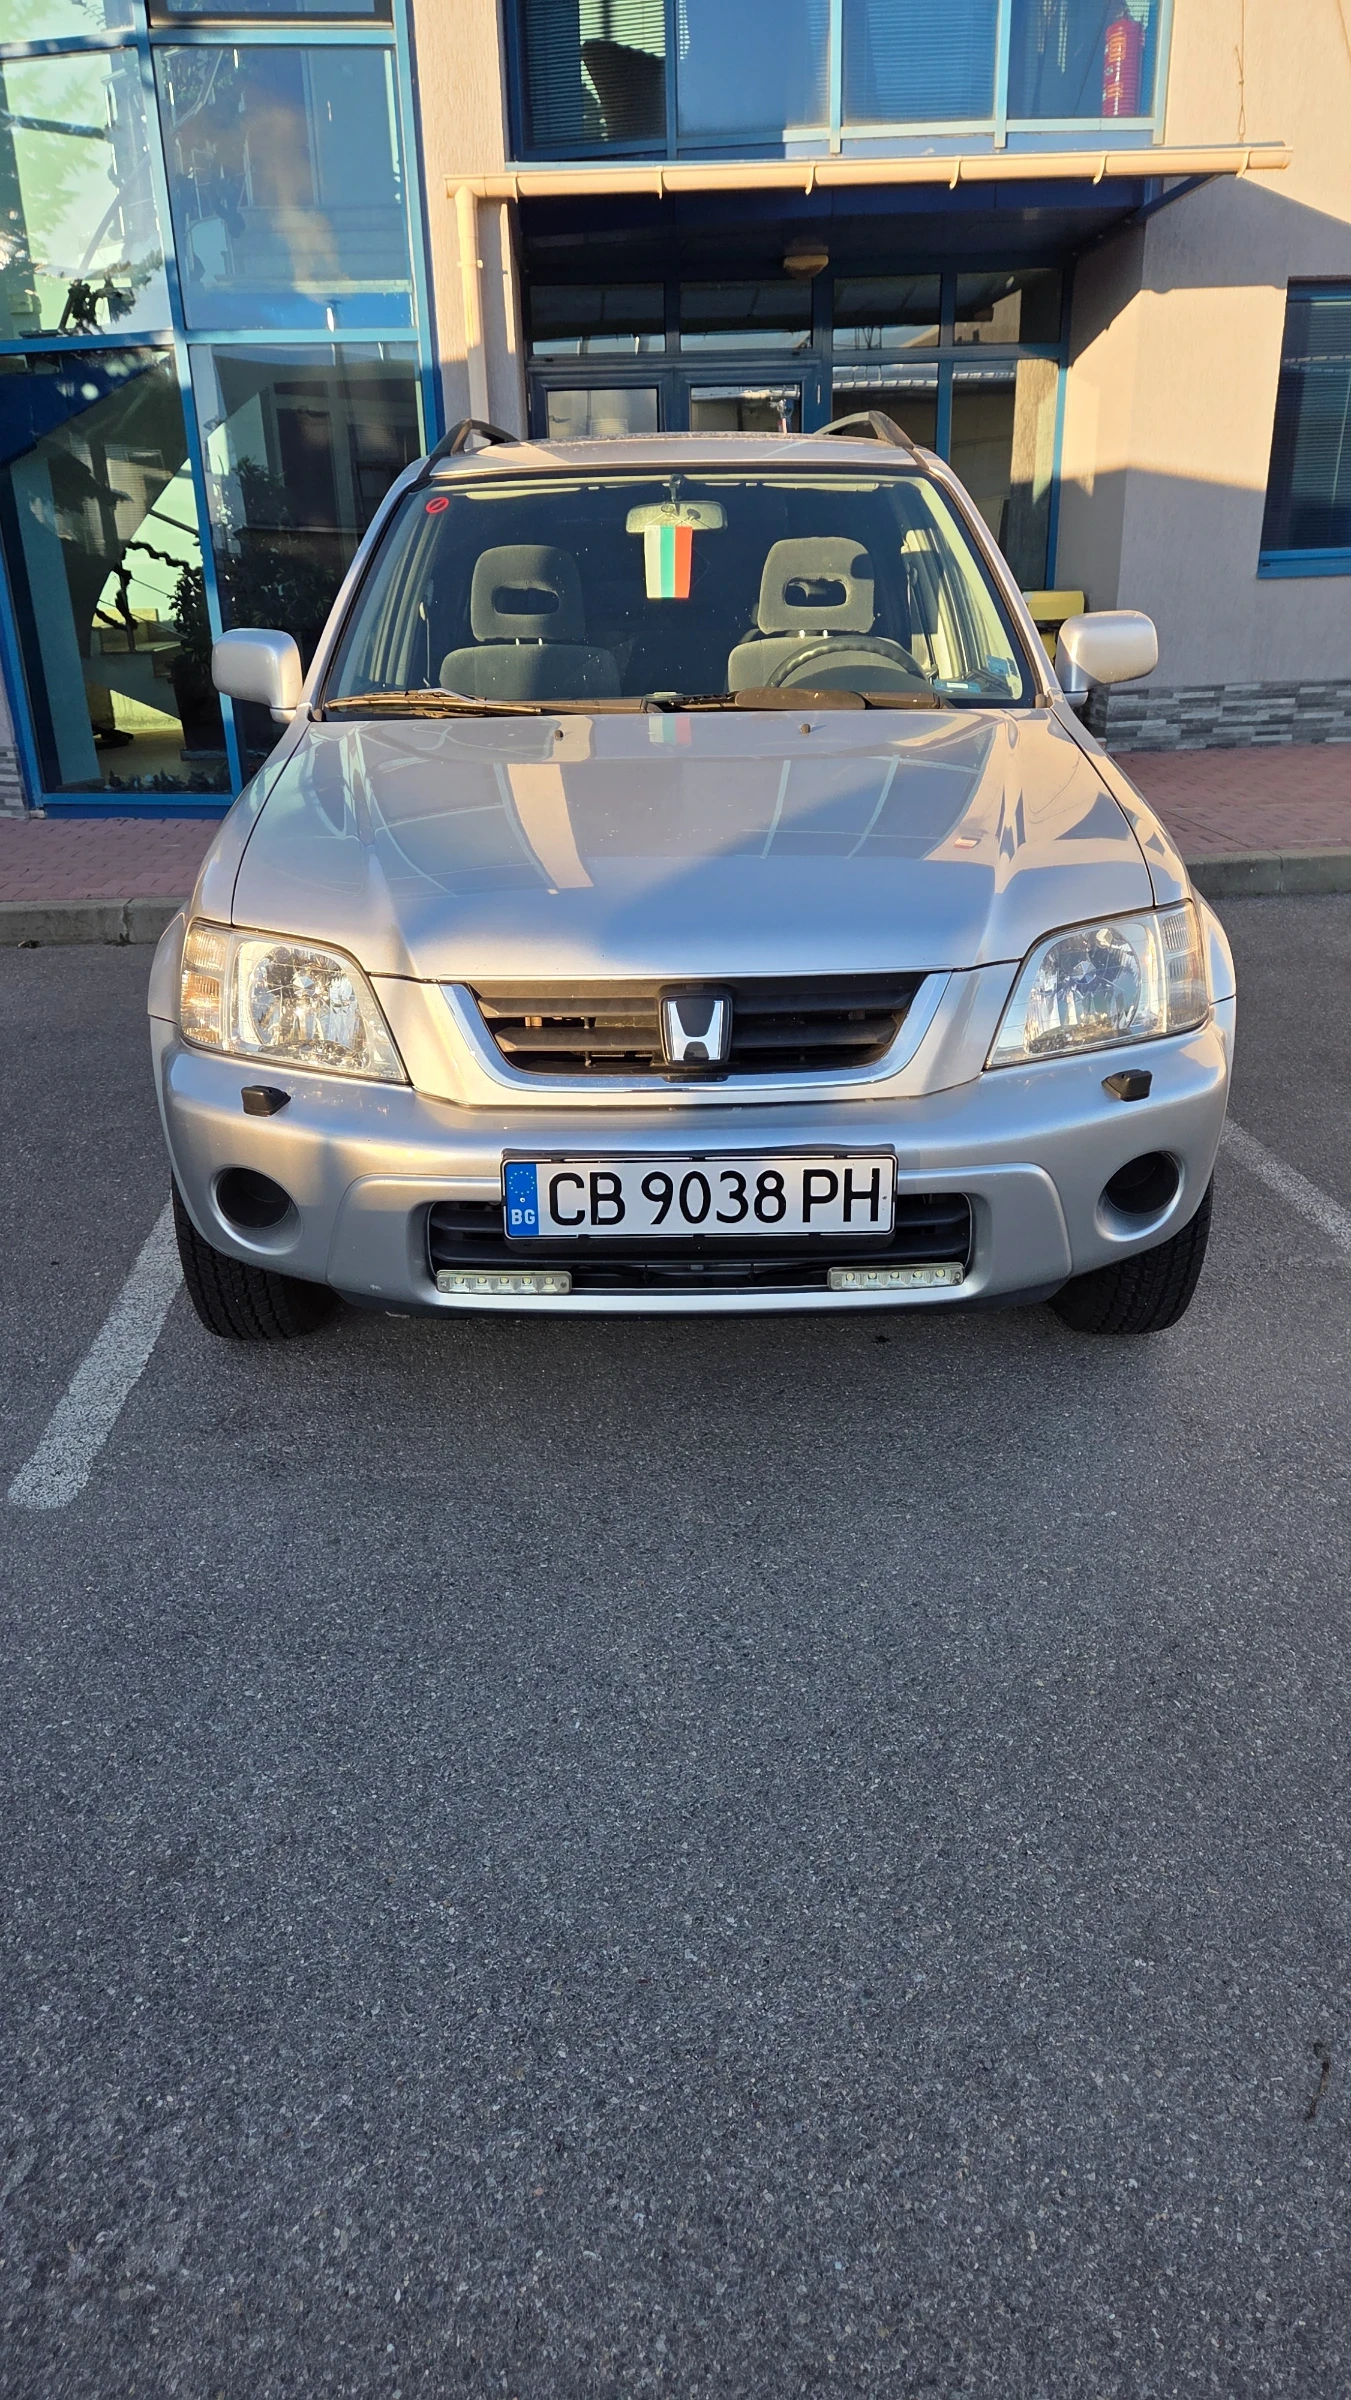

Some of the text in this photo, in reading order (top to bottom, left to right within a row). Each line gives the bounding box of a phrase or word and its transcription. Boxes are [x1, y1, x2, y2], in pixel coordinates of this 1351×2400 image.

[549, 1167, 881, 1226] CB 9038 PH
[511, 1209, 535, 1225] BG
